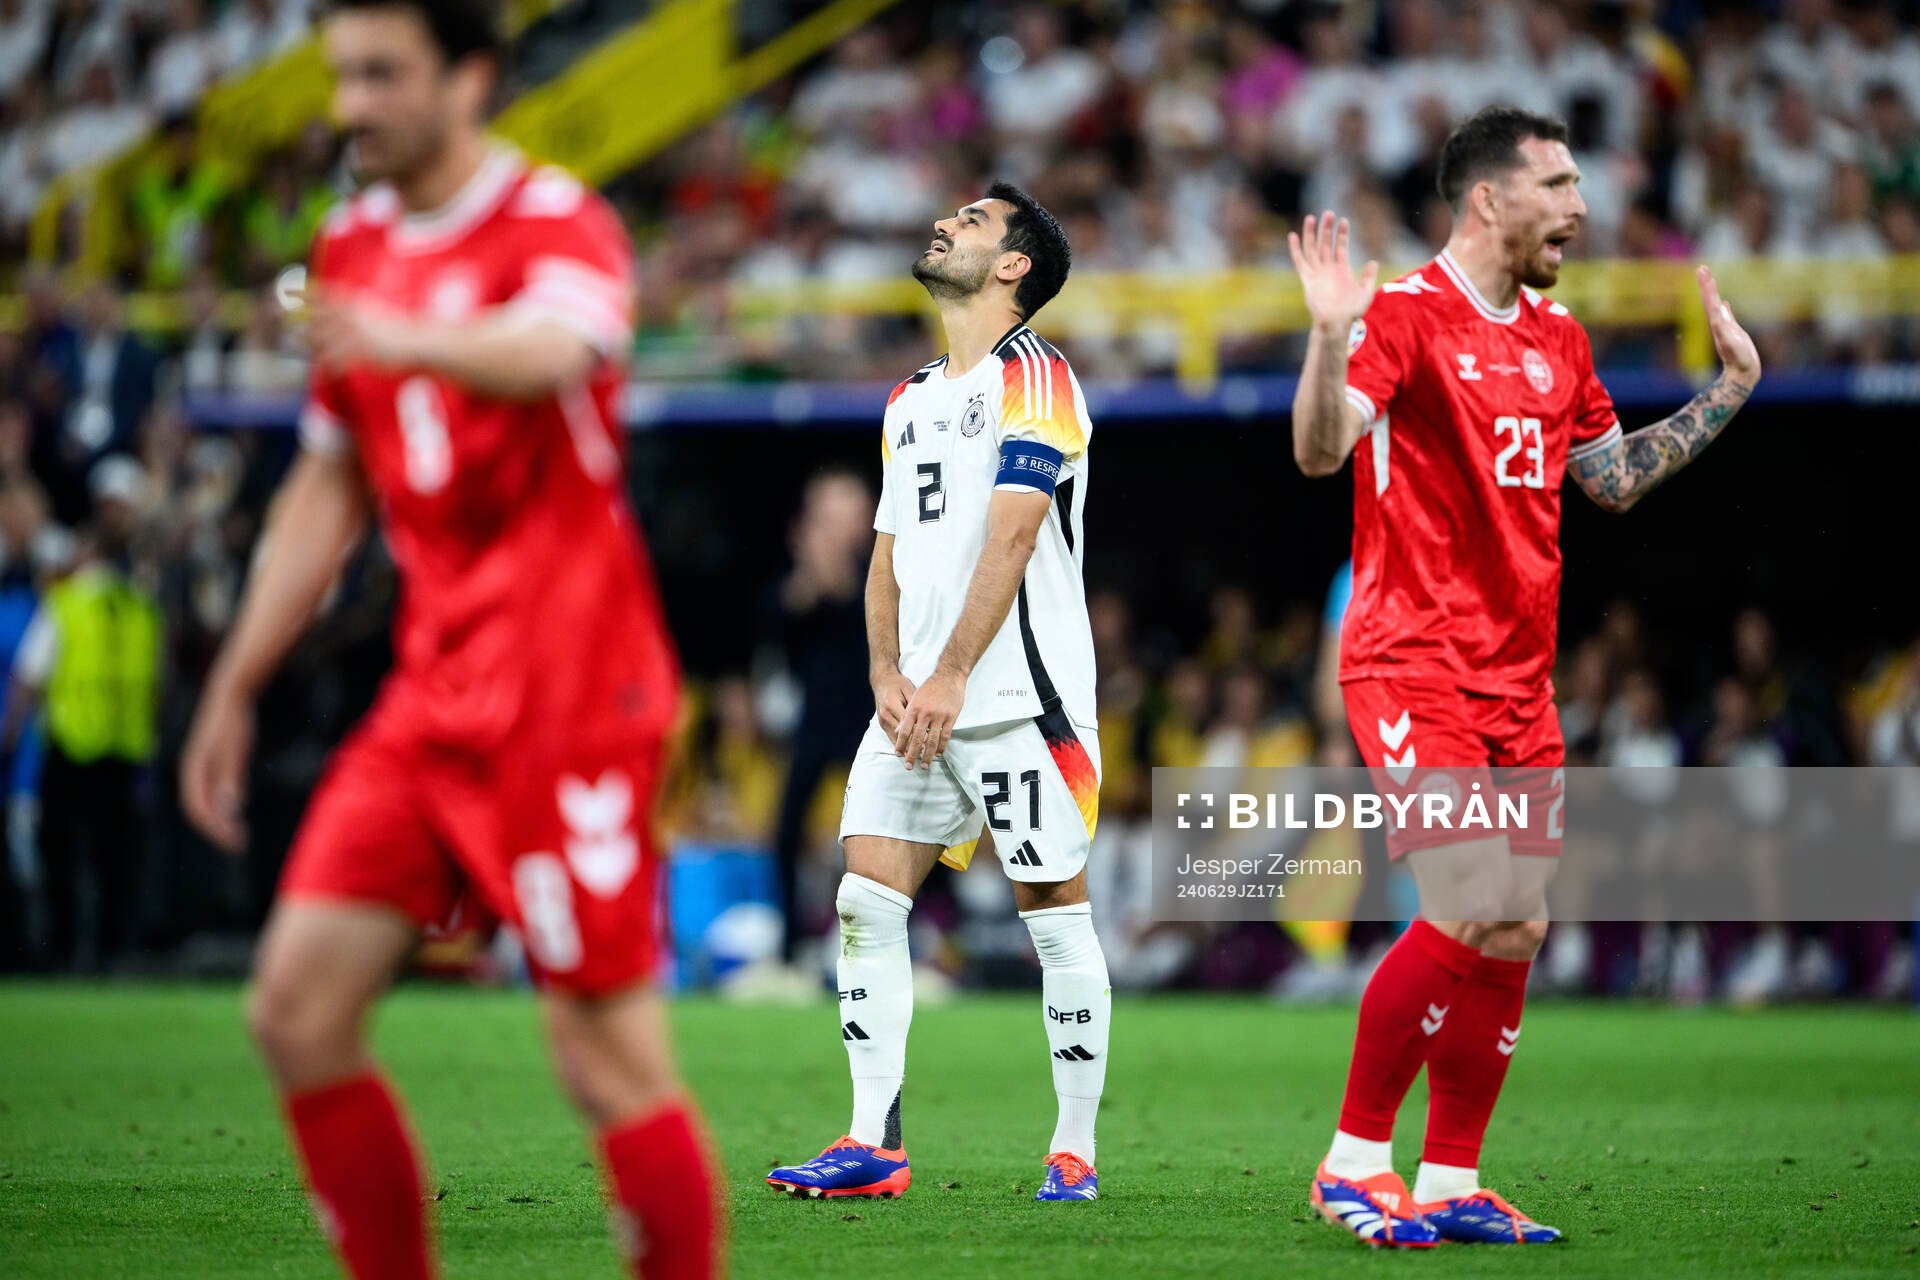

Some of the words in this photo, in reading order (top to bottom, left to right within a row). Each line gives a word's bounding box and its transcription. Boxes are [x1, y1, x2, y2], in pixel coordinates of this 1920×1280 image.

[1494, 415, 1544, 488] 23
[981, 769, 1042, 833] 21
[838, 988, 868, 1003] FB
[1048, 1005, 1092, 1024] DFB
